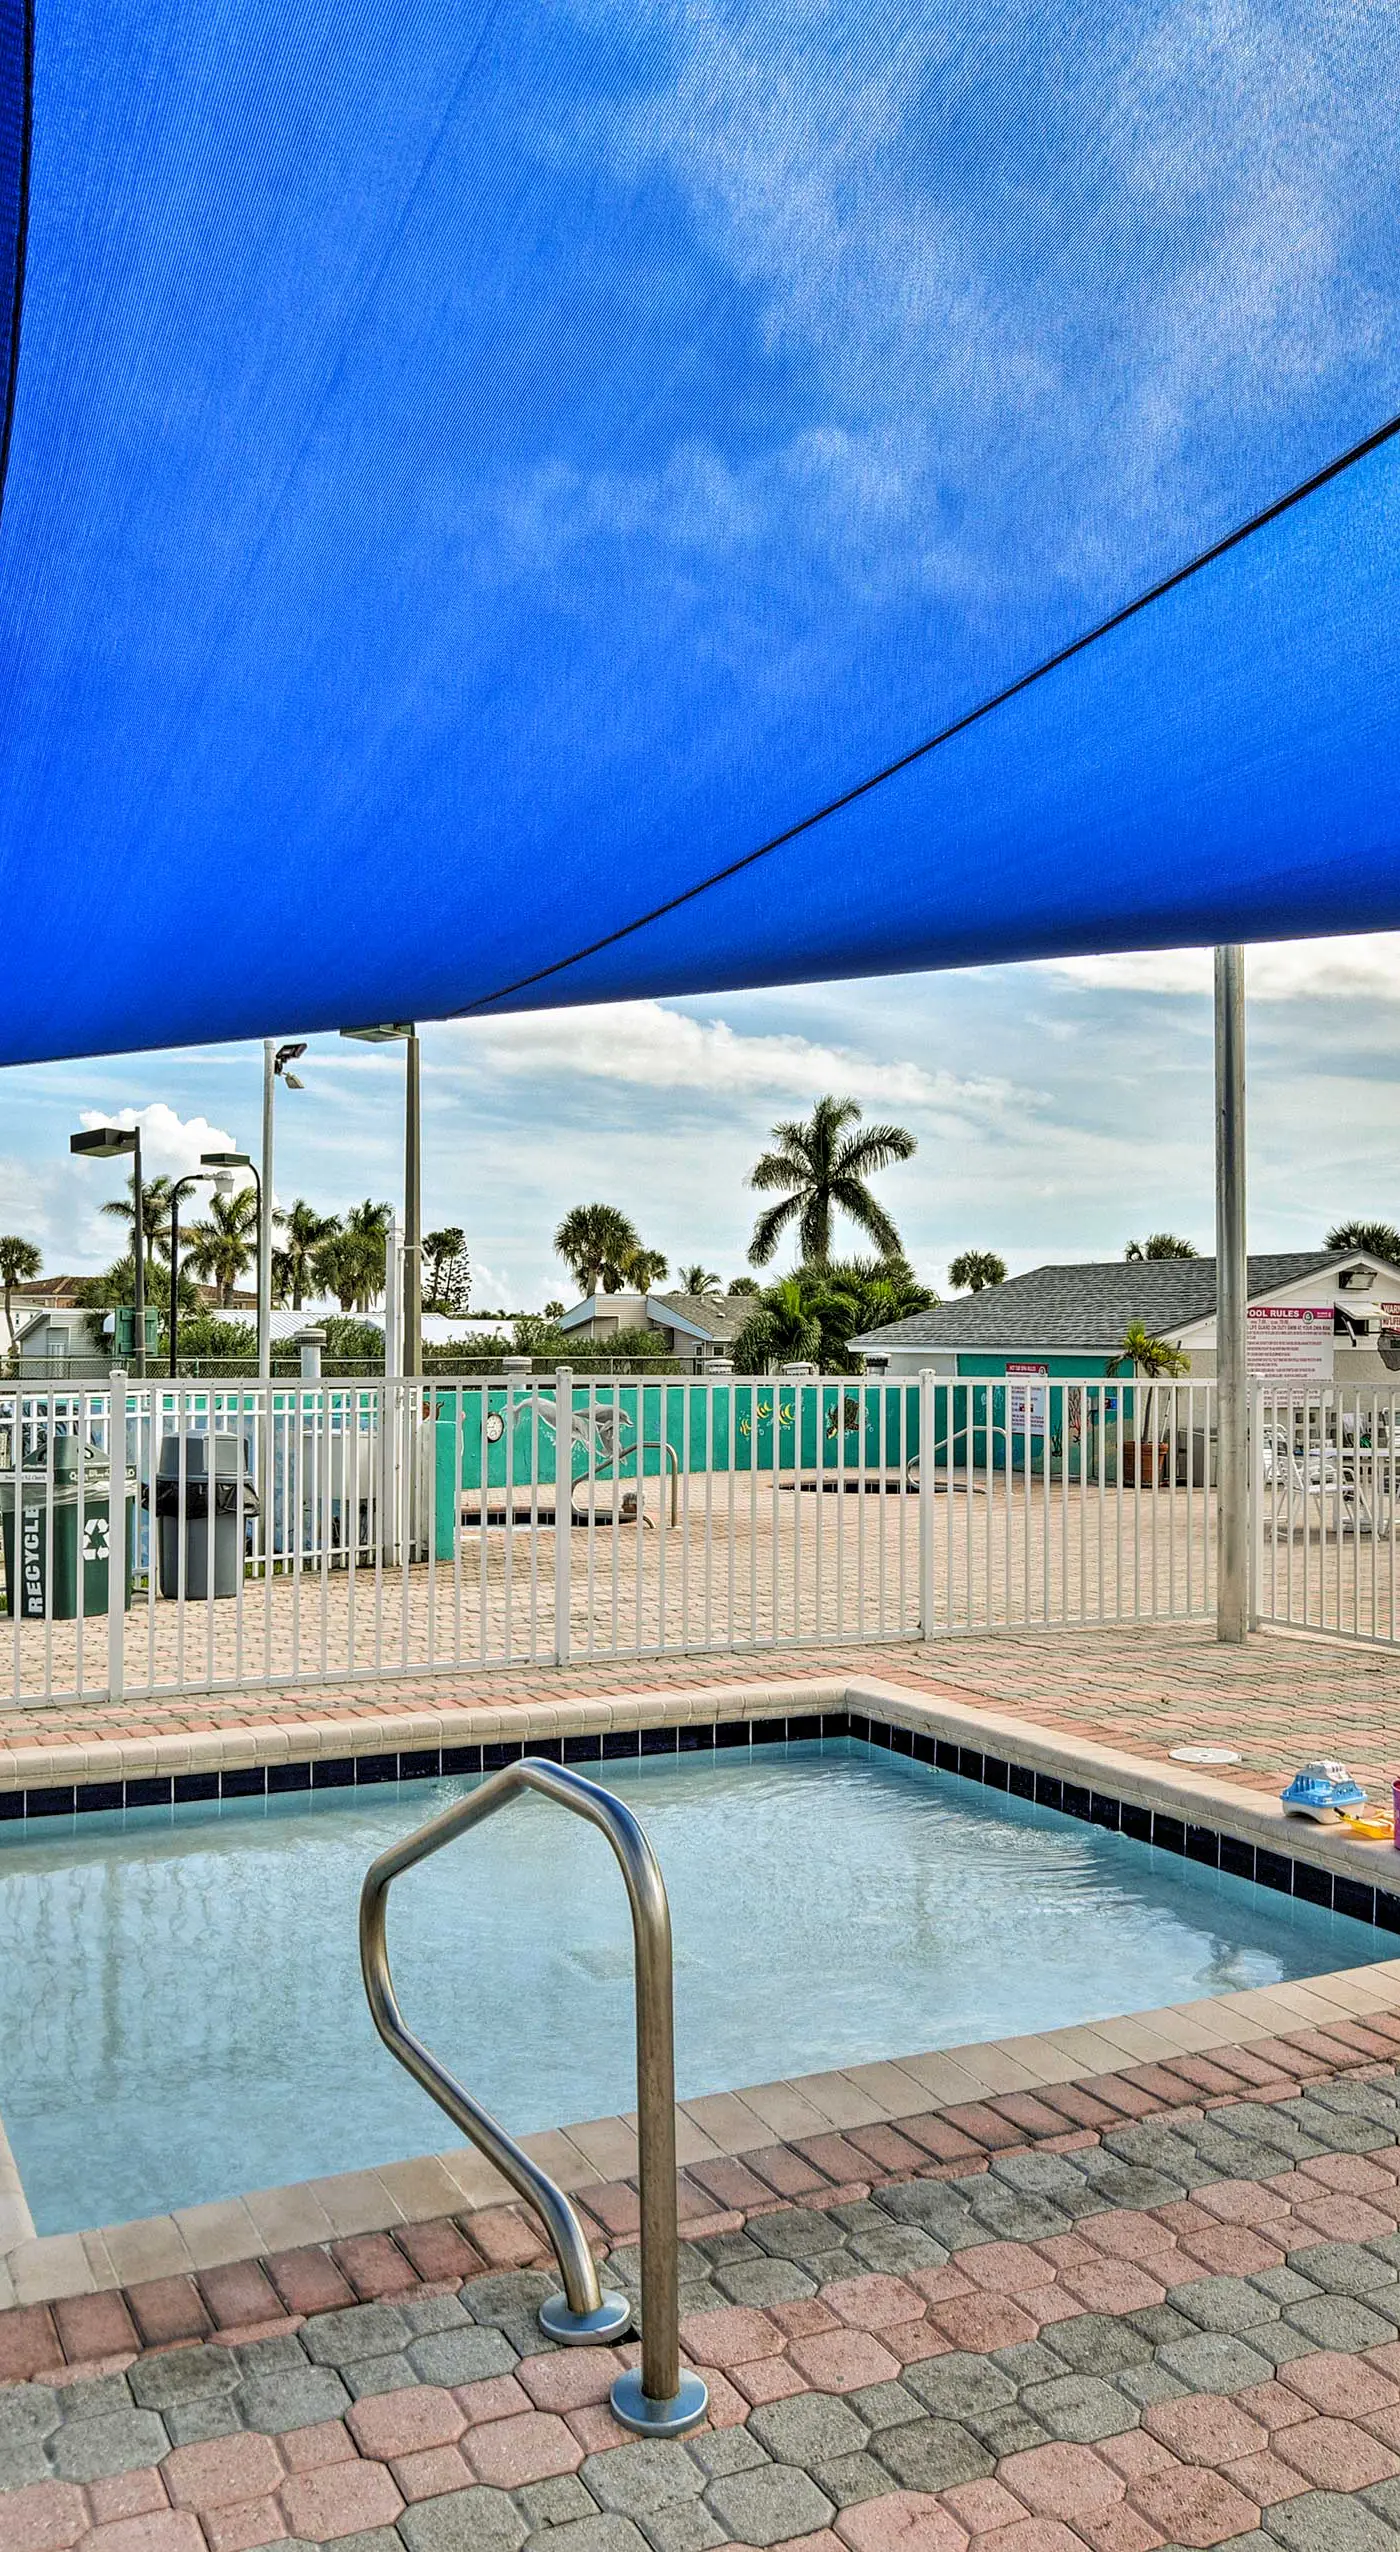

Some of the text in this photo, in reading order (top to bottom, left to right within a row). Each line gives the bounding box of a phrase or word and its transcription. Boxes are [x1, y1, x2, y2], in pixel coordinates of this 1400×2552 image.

[1247, 1309, 1299, 1318] OOL RULES
[25, 1505, 43, 1613] RECYCLE
